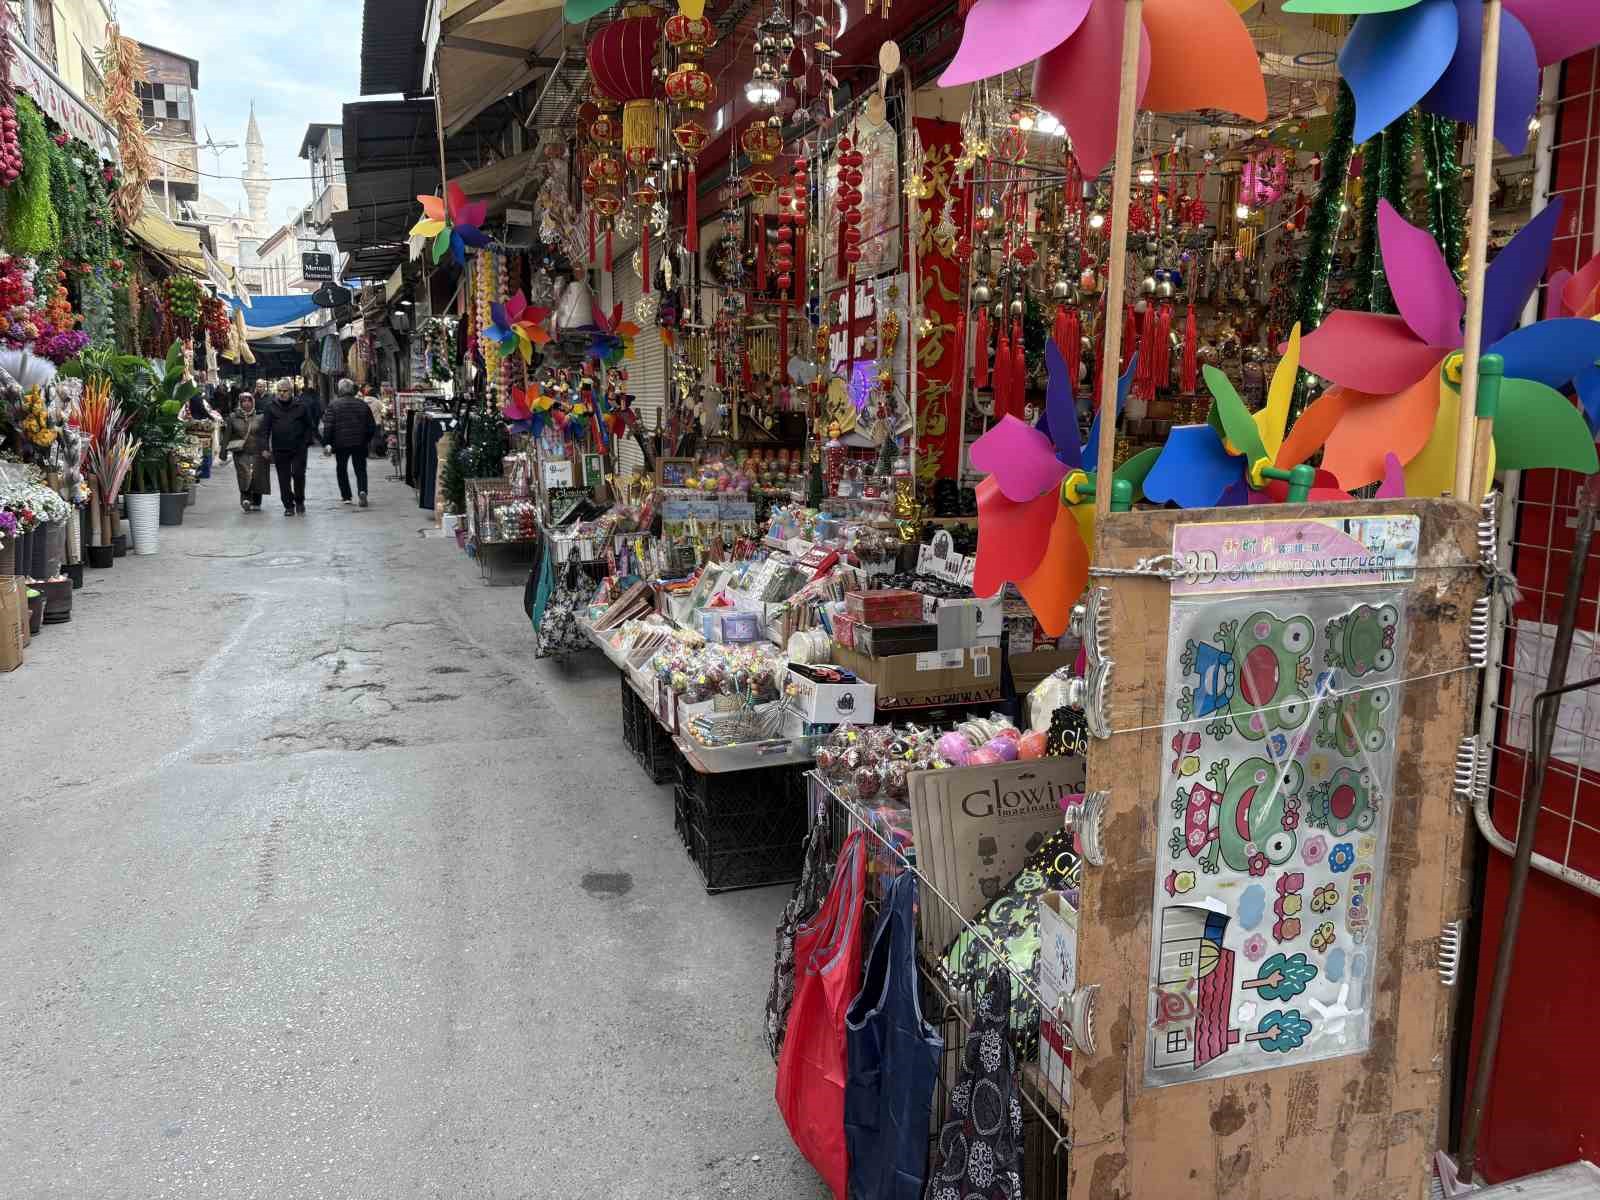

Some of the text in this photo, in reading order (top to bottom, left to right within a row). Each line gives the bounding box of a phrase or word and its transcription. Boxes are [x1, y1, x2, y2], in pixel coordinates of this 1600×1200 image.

[1184, 550, 1217, 585] 3D
[1061, 728, 1087, 752] Glo
[998, 803, 1059, 817] Imaginati
